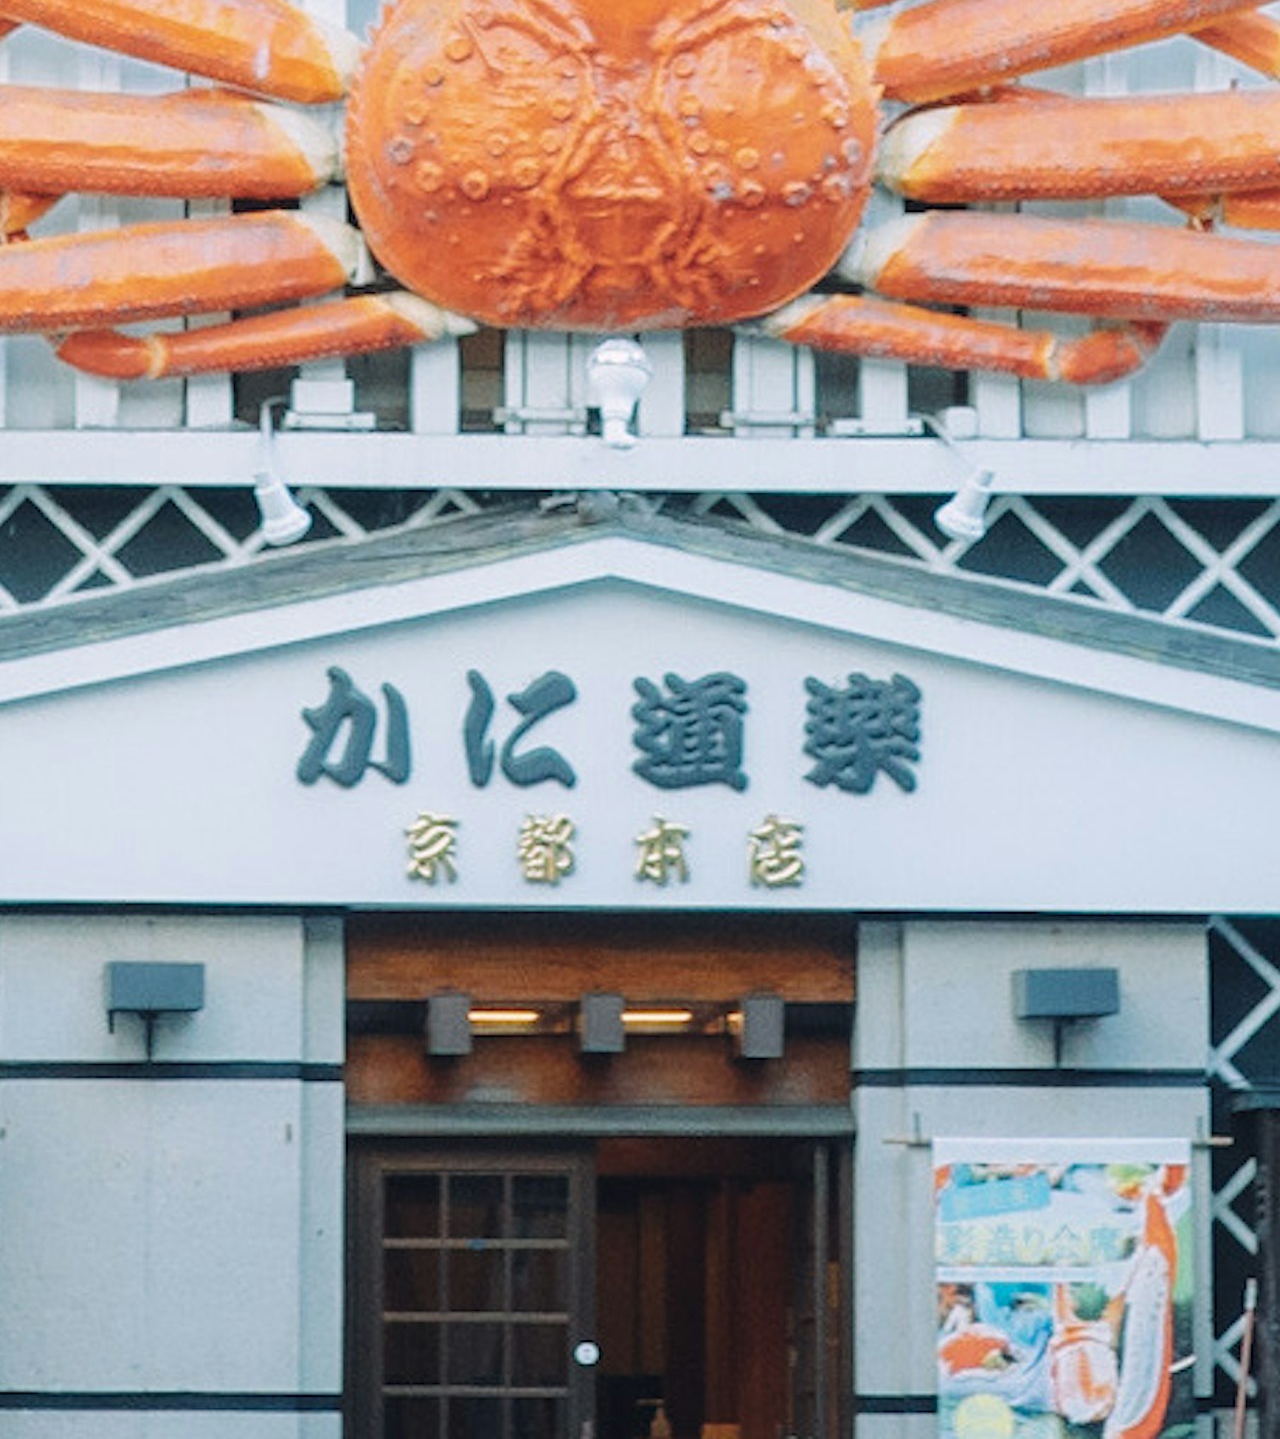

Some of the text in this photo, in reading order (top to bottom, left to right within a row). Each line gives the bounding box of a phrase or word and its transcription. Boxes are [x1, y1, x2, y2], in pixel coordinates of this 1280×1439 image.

[295, 664, 925, 795] かに道楽
[403, 812, 808, 888] 京都本店
